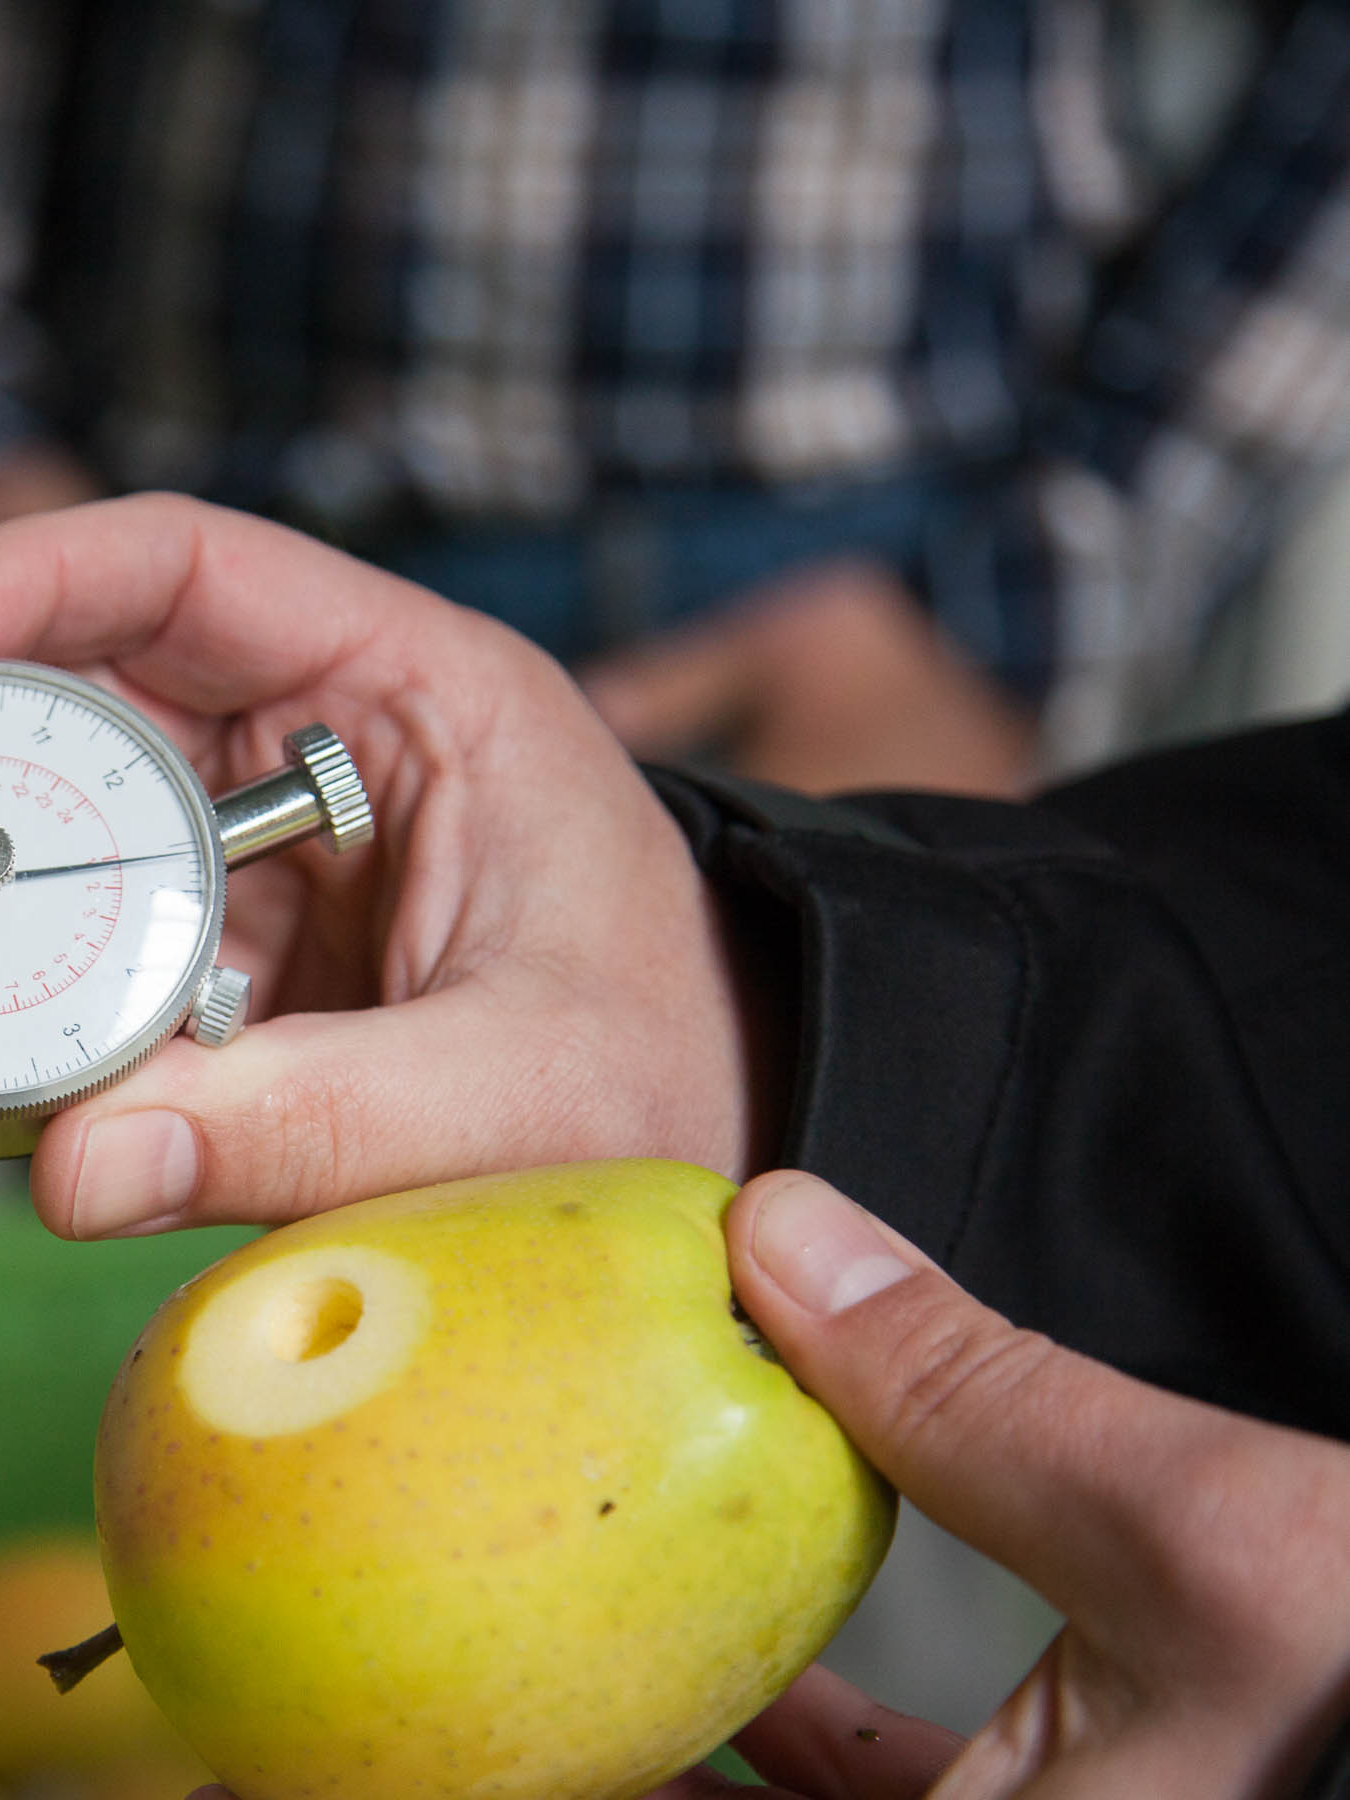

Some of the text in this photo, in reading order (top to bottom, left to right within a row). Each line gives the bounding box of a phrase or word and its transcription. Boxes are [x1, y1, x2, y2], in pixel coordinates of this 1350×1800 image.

[33, 727, 52, 744] 11
[103, 768, 124, 790] 12
[12, 783, 29, 798] 22
[35, 793, 52, 808] 23
[58, 808, 74, 823] 24
[86, 881, 101, 891] 2
[54, 954, 67, 964] 5
[32, 971, 46, 980] 6
[4, 980, 18, 989] 7
[63, 1024, 80, 1036] 3
